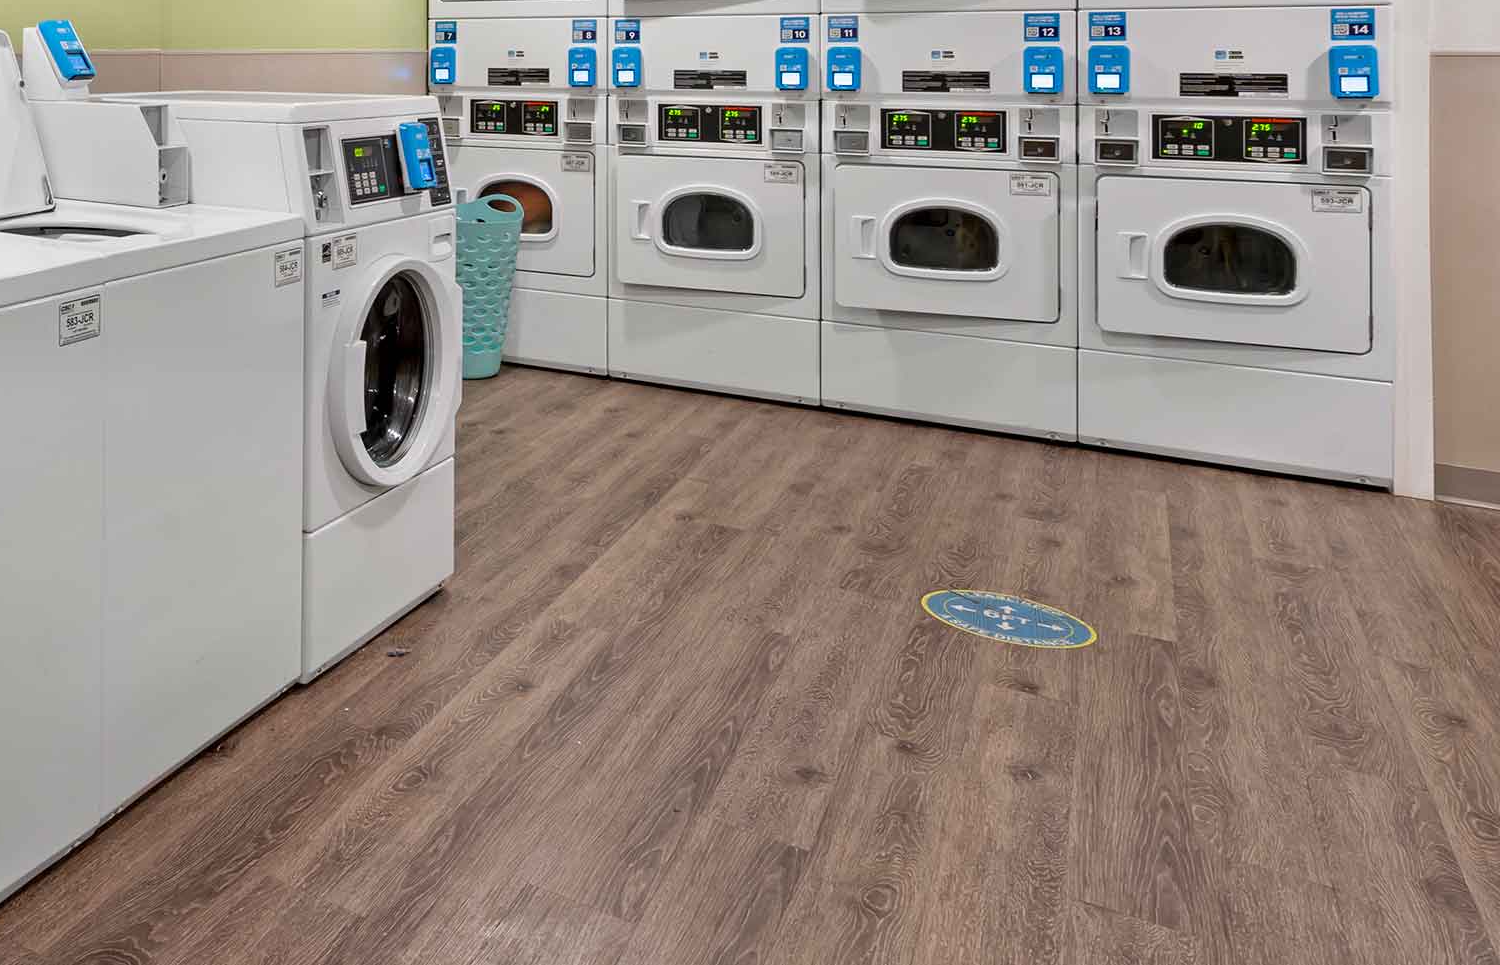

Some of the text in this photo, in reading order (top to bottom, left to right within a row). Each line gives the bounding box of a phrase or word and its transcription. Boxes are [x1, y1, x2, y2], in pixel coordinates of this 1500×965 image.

[794, 30, 806, 39] 10
[843, 28, 853, 37] 11
[1042, 28, 1055, 37] 12
[1106, 26, 1121, 36] 13
[1352, 25, 1370, 35] 14
[447, 32, 453, 40] 7
[586, 31, 592, 39] 8
[67, 312, 94, 328] 583-JCR
